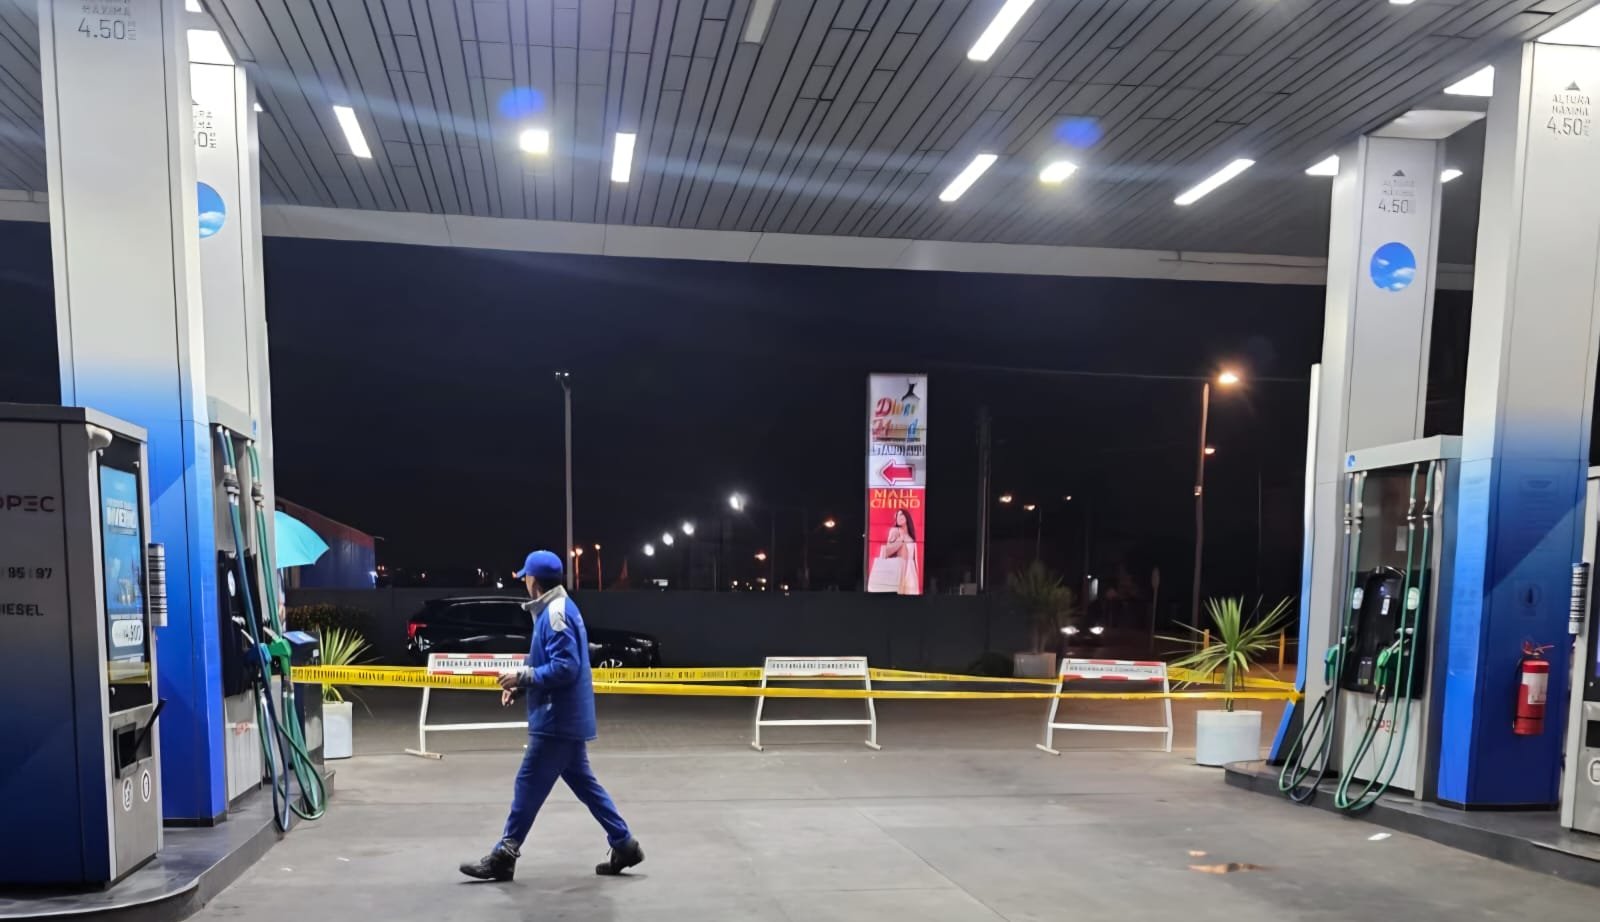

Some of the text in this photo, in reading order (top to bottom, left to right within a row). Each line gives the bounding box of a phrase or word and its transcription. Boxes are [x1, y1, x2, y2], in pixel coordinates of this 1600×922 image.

[78, 17, 125, 39] 4.50
[1546, 115, 1583, 136] 4.50
[1378, 198, 1409, 214] 4.50
[873, 488, 919, 499] MALL
[0, 495, 55, 512] PEC
[35, 567, 53, 580] 97
[0, 603, 45, 617] IESEL
